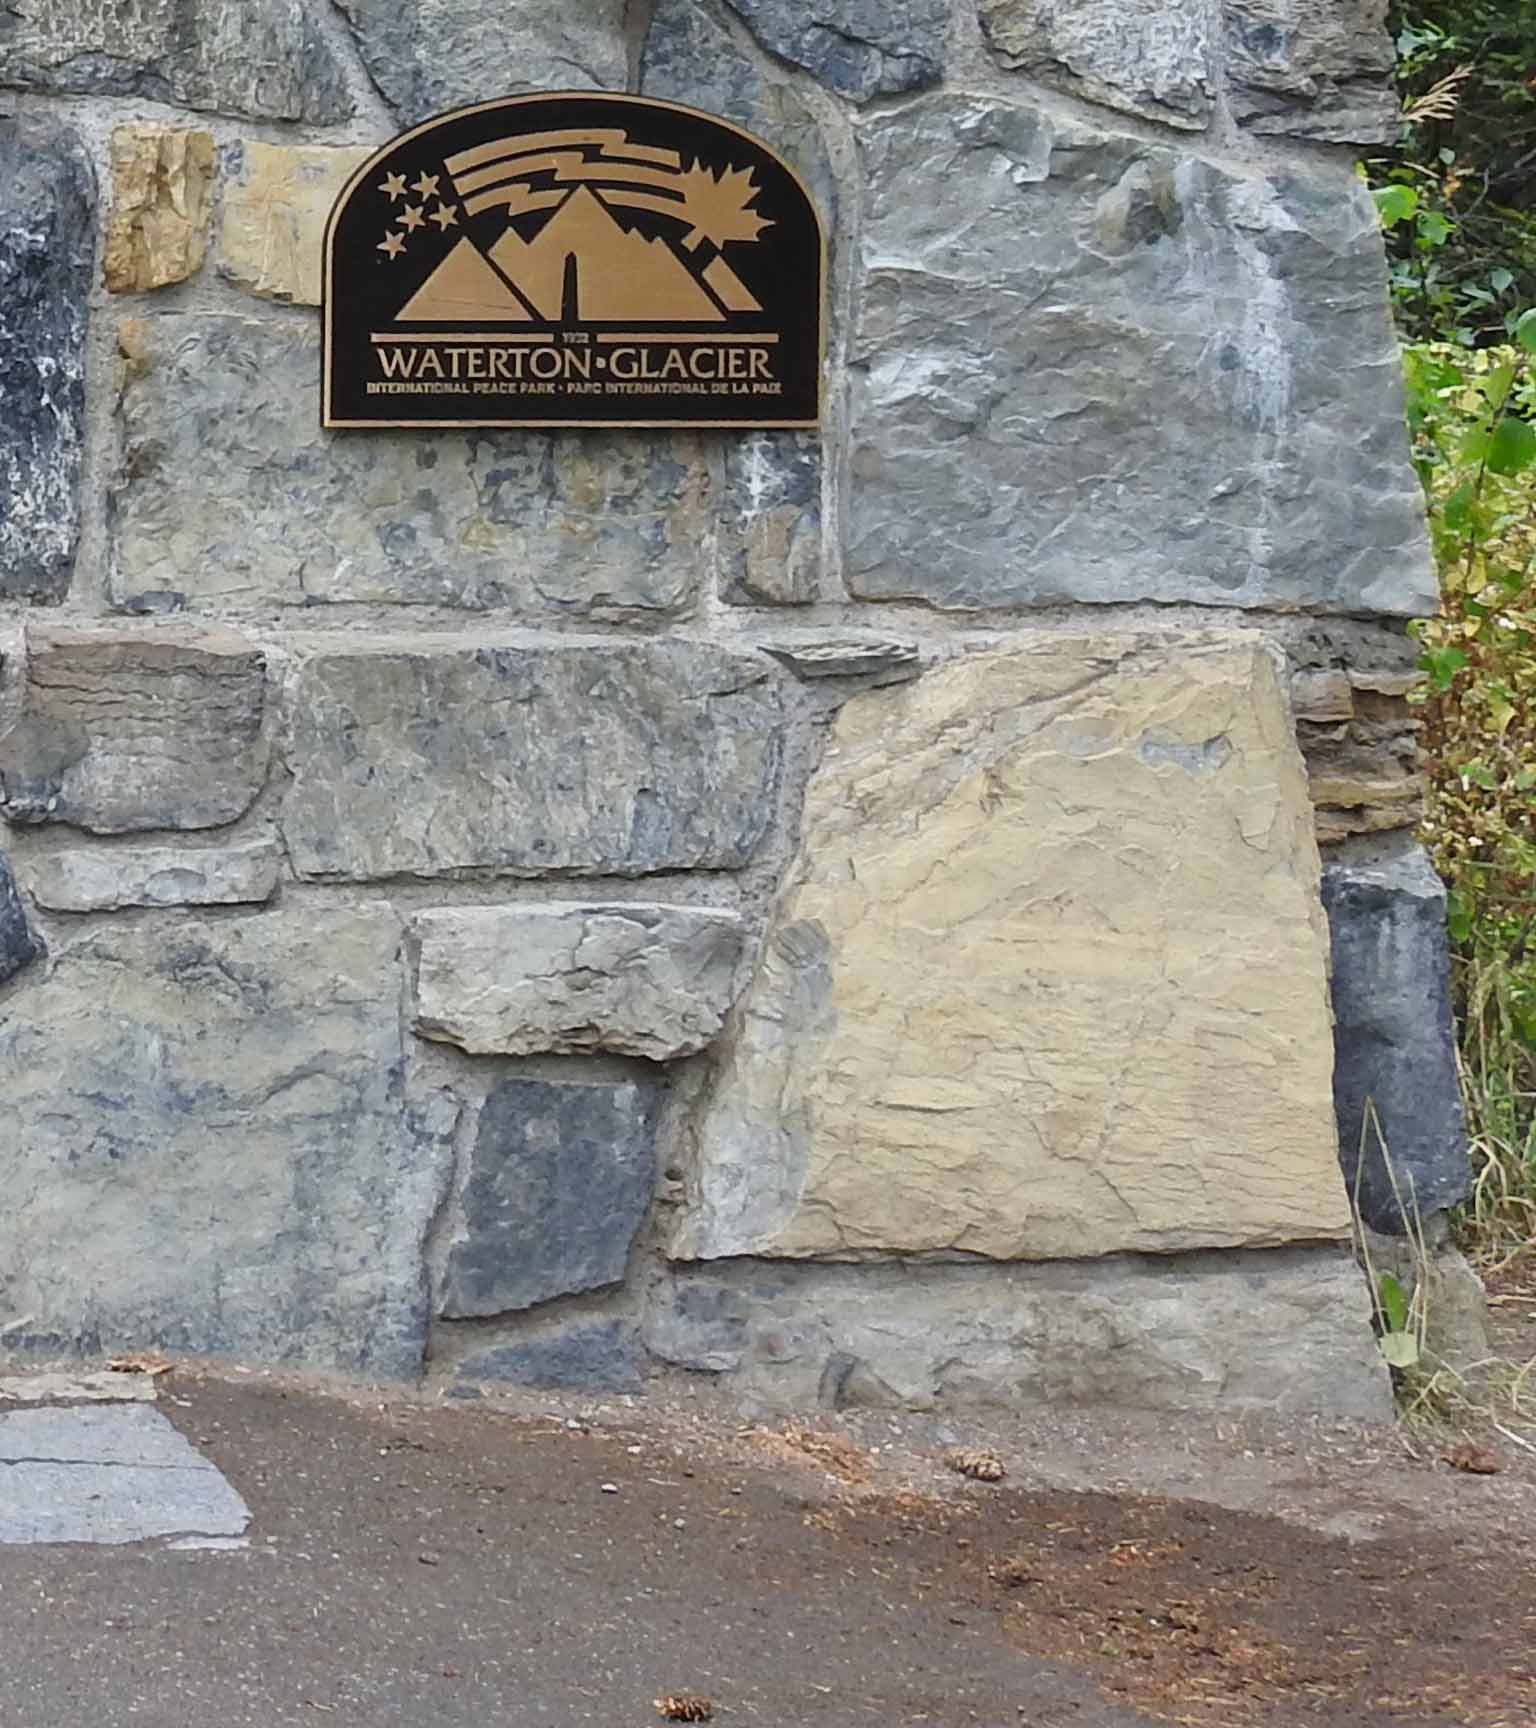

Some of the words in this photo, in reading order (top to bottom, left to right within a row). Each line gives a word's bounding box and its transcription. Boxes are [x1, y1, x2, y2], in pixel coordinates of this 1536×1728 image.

[367, 382, 470, 394] INTERNATIONAL
[473, 382, 517, 394] PEACE
[520, 382, 556, 394] PARK
[567, 382, 602, 394] PARC
[605, 382, 708, 394] INTERNATIONAL
[712, 382, 729, 394] DE
[732, 382, 750, 394] LA
